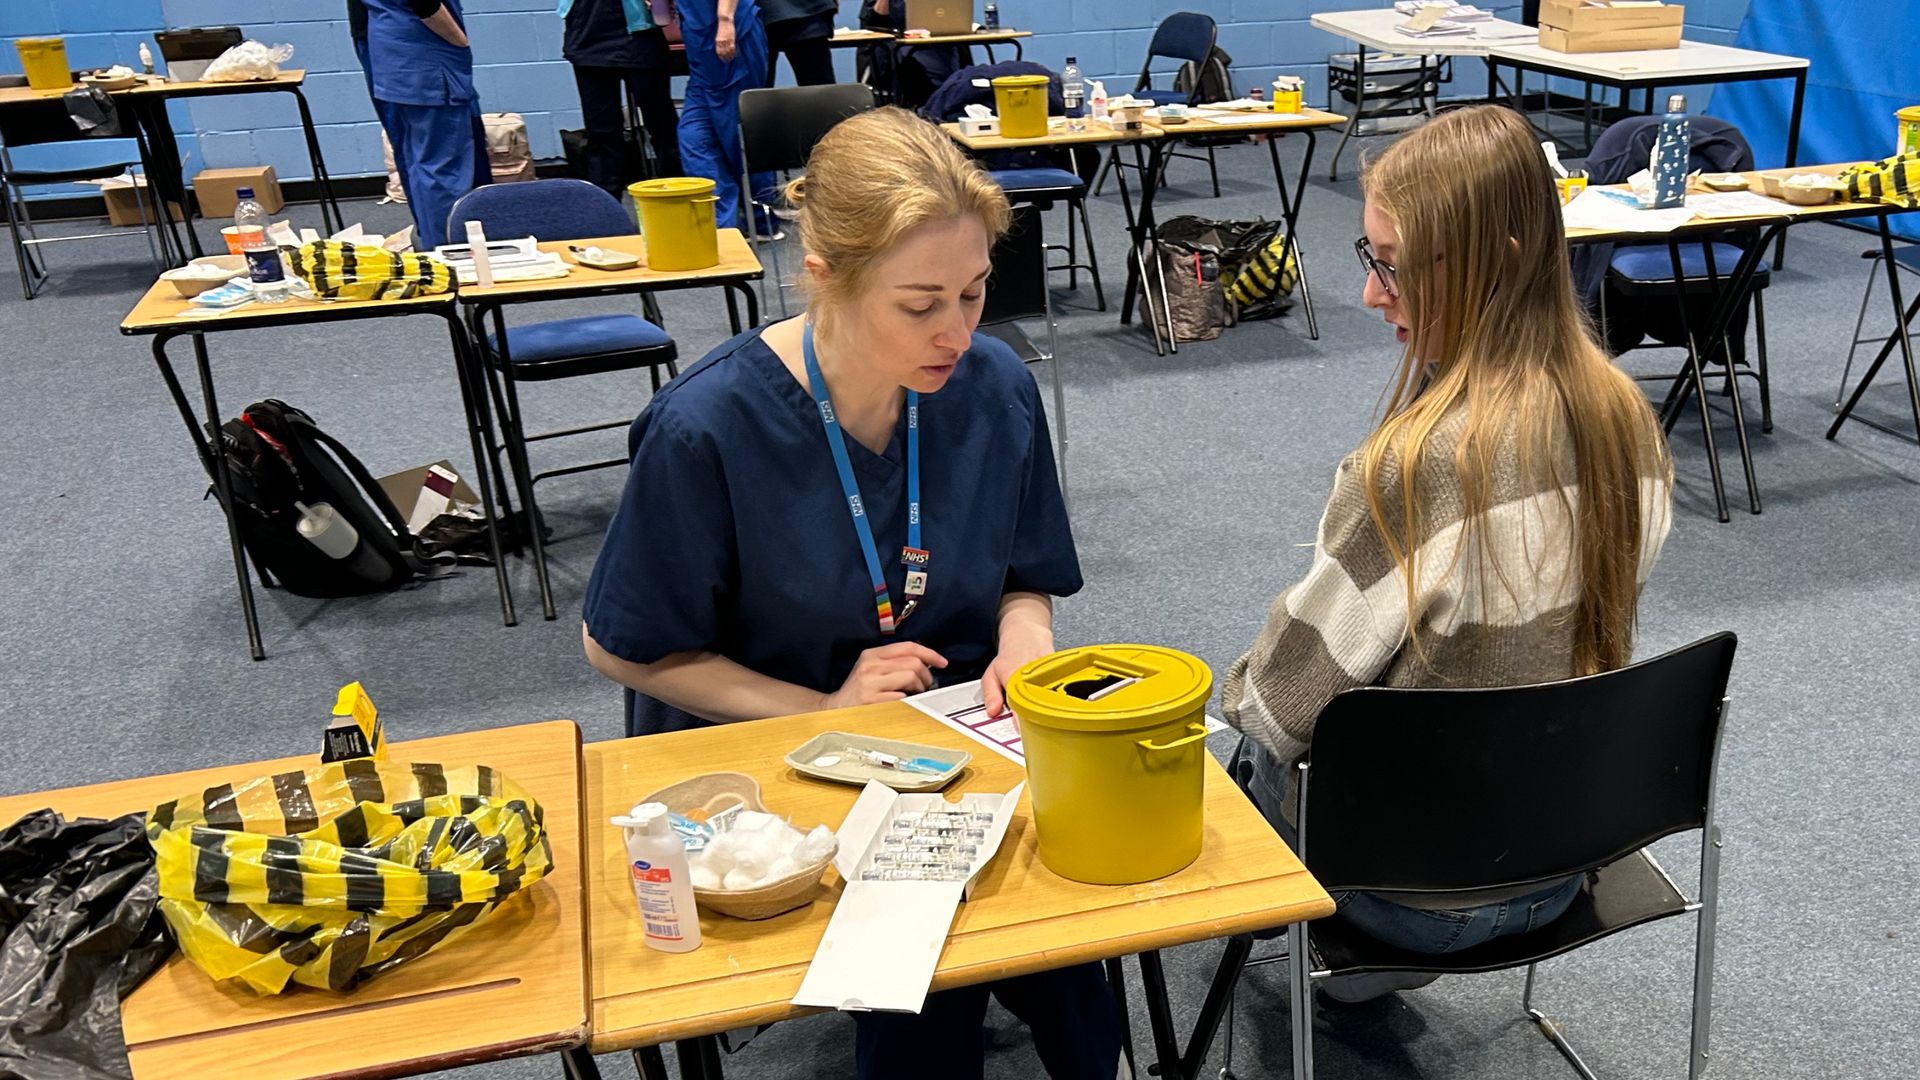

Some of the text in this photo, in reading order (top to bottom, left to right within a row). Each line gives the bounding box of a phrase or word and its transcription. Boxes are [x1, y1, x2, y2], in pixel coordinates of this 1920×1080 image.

[850, 495, 863, 516] NHS
[910, 503, 919, 524] NHS
[905, 551, 926, 563] NHS
